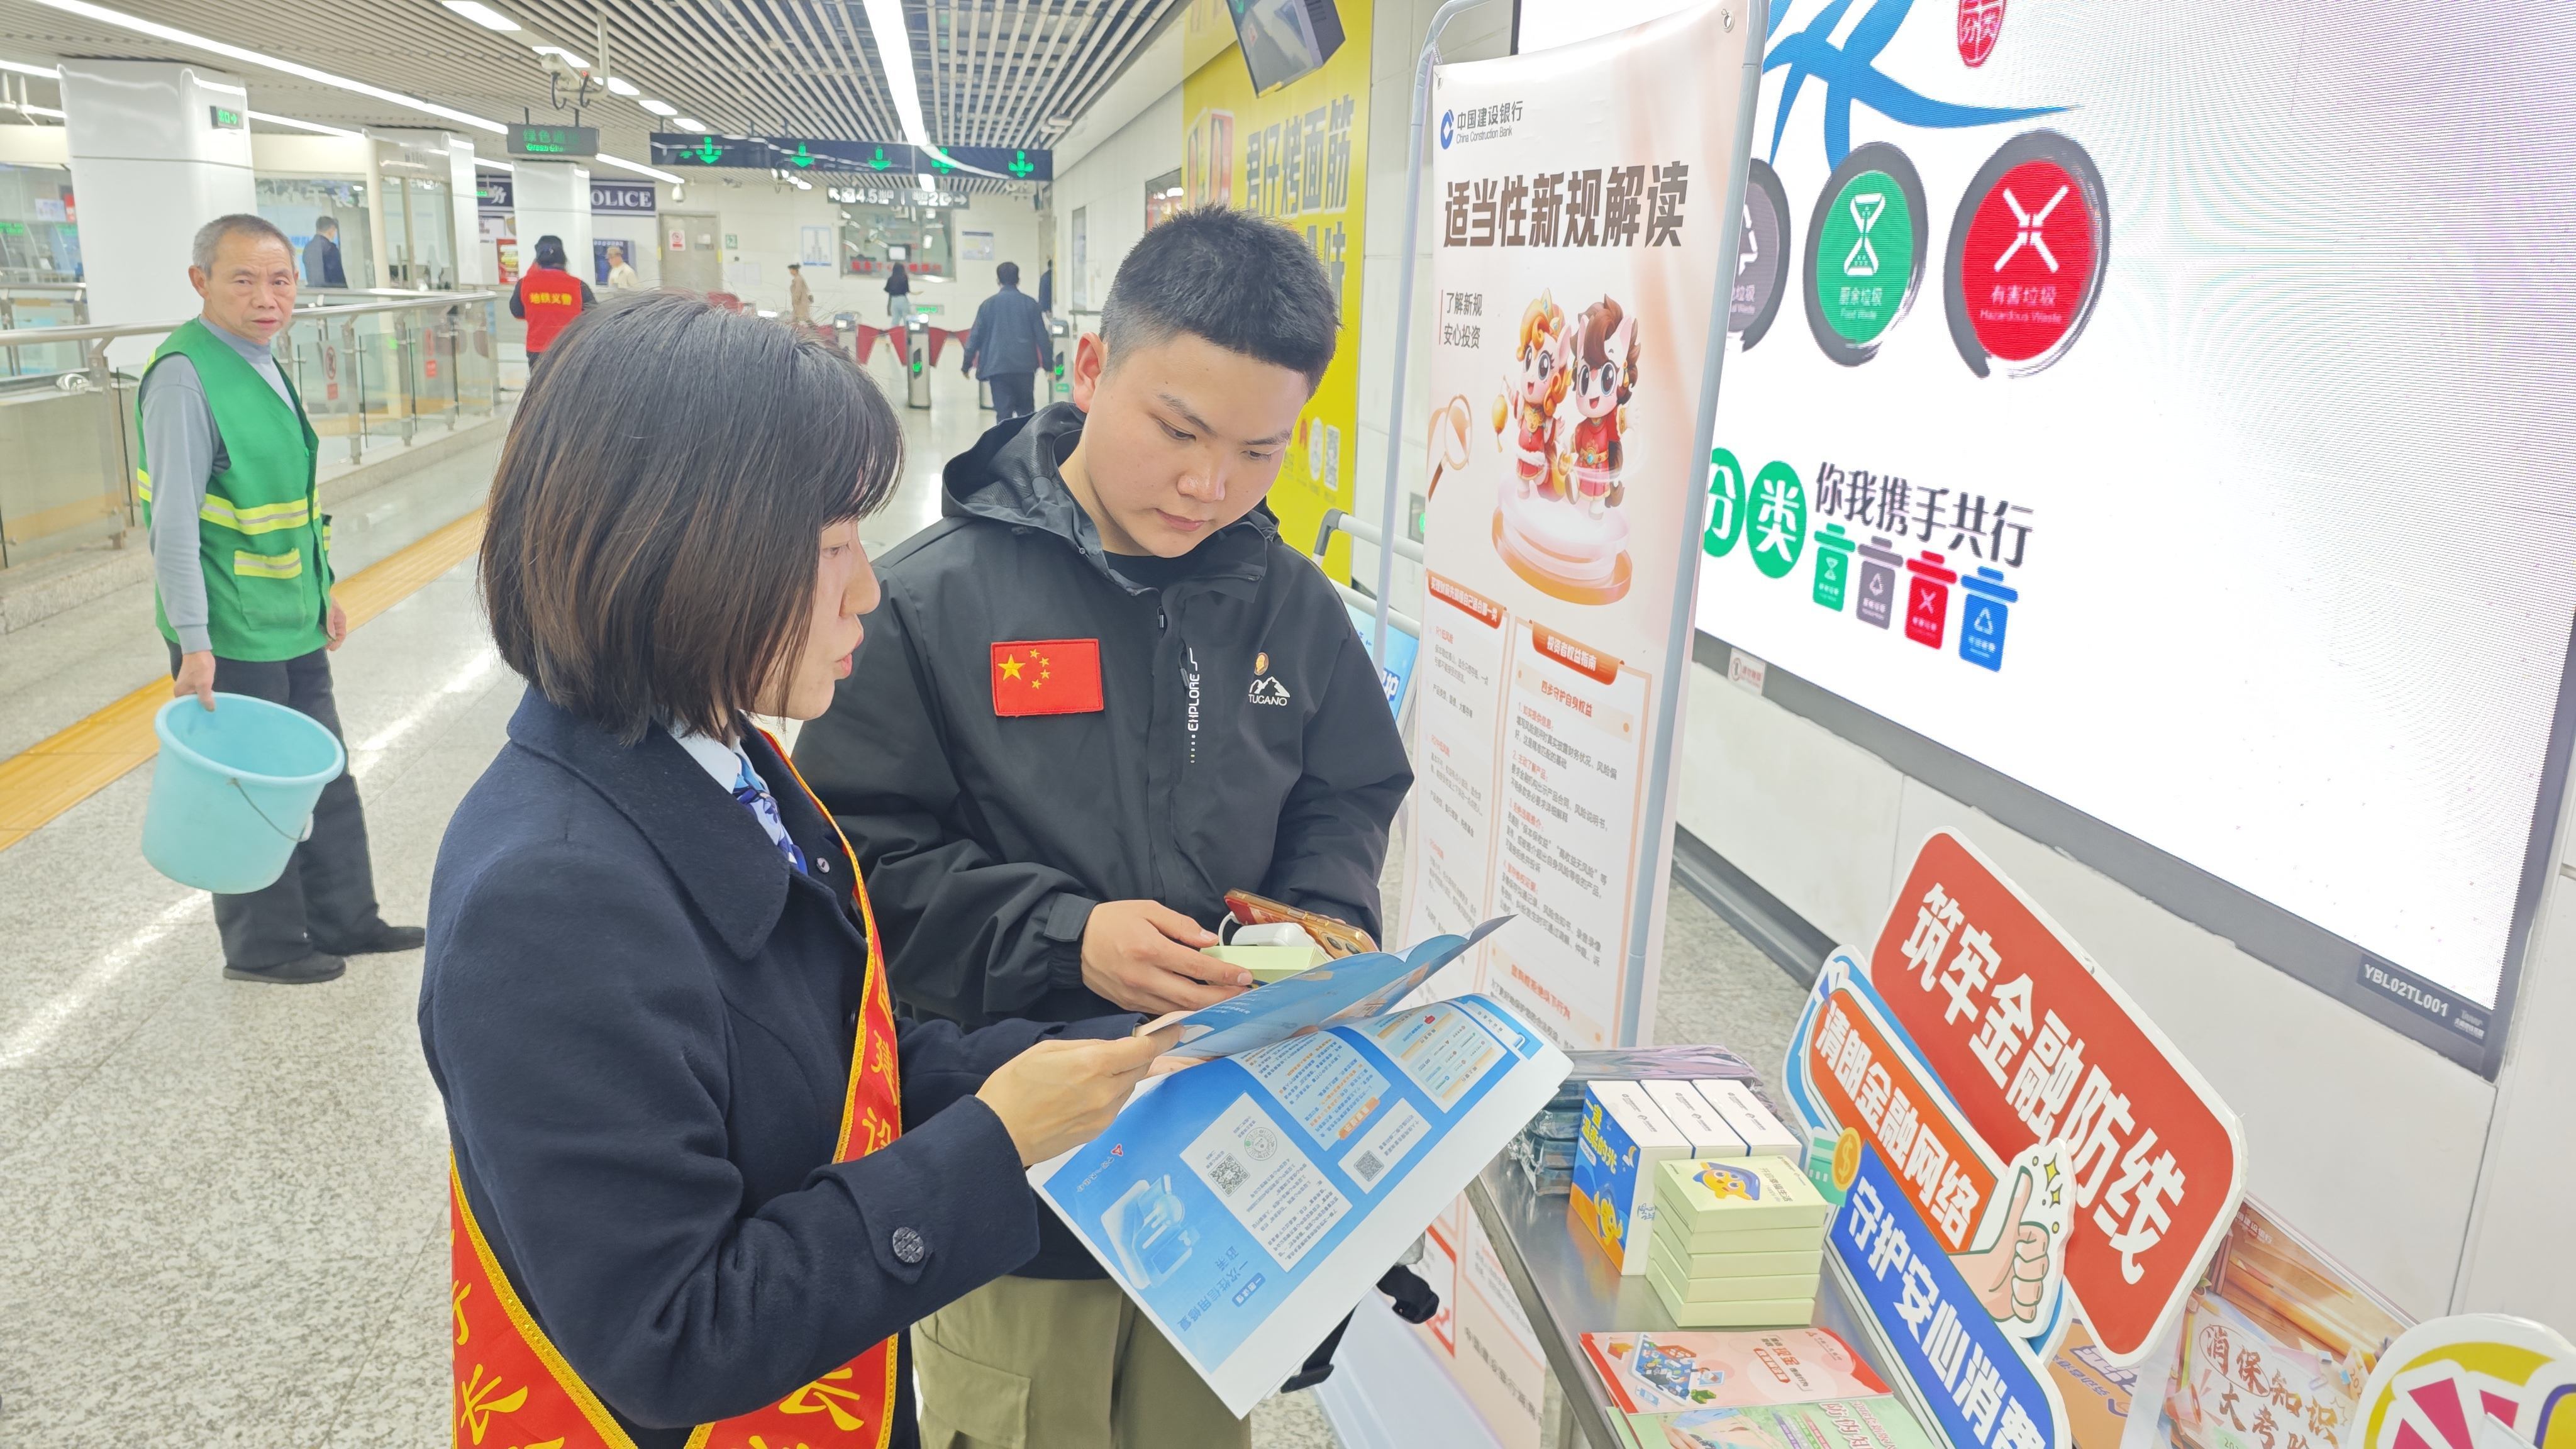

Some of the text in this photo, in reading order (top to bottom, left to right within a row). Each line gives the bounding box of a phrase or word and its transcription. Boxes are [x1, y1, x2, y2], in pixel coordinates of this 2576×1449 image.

[1456, 125, 1513, 144] China Construction Bank
[1457, 101, 1523, 130] 中国建设银行
[1246, 94, 1355, 218] 君仔烤面筋
[591, 190, 652, 208] OLICE
[1443, 160, 1689, 248] 适当性新规解读
[1446, 292, 1482, 316] 了解新规
[1991, 285, 2057, 307] 有害垃圾
[1443, 323, 1481, 350] 安心投资
[1815, 461, 2035, 569] 你我携手共行
[1546, 634, 1597, 672] 投资者权益指南
[1187, 674, 1200, 731] EXPLORE
[1248, 694, 1287, 706] TUCANO
[1541, 679, 1592, 718] 四步守护自身权益
[2364, 963, 2449, 1017] YBL02TL001
[1901, 882, 2186, 1285] 筑牢金融防线
[1814, 1001, 1981, 1255] 清朗金融网络
[2236, 1211, 2273, 1245] 国建设银行
[1213, 1245, 1240, 1272] 政策
[1176, 1260, 1248, 1332] 一次性信用修复
[1848, 1176, 2048, 1449] 守护安心消费
[1772, 1347, 1801, 1366] 现金
[2206, 1323, 2340, 1449] 消保知识
